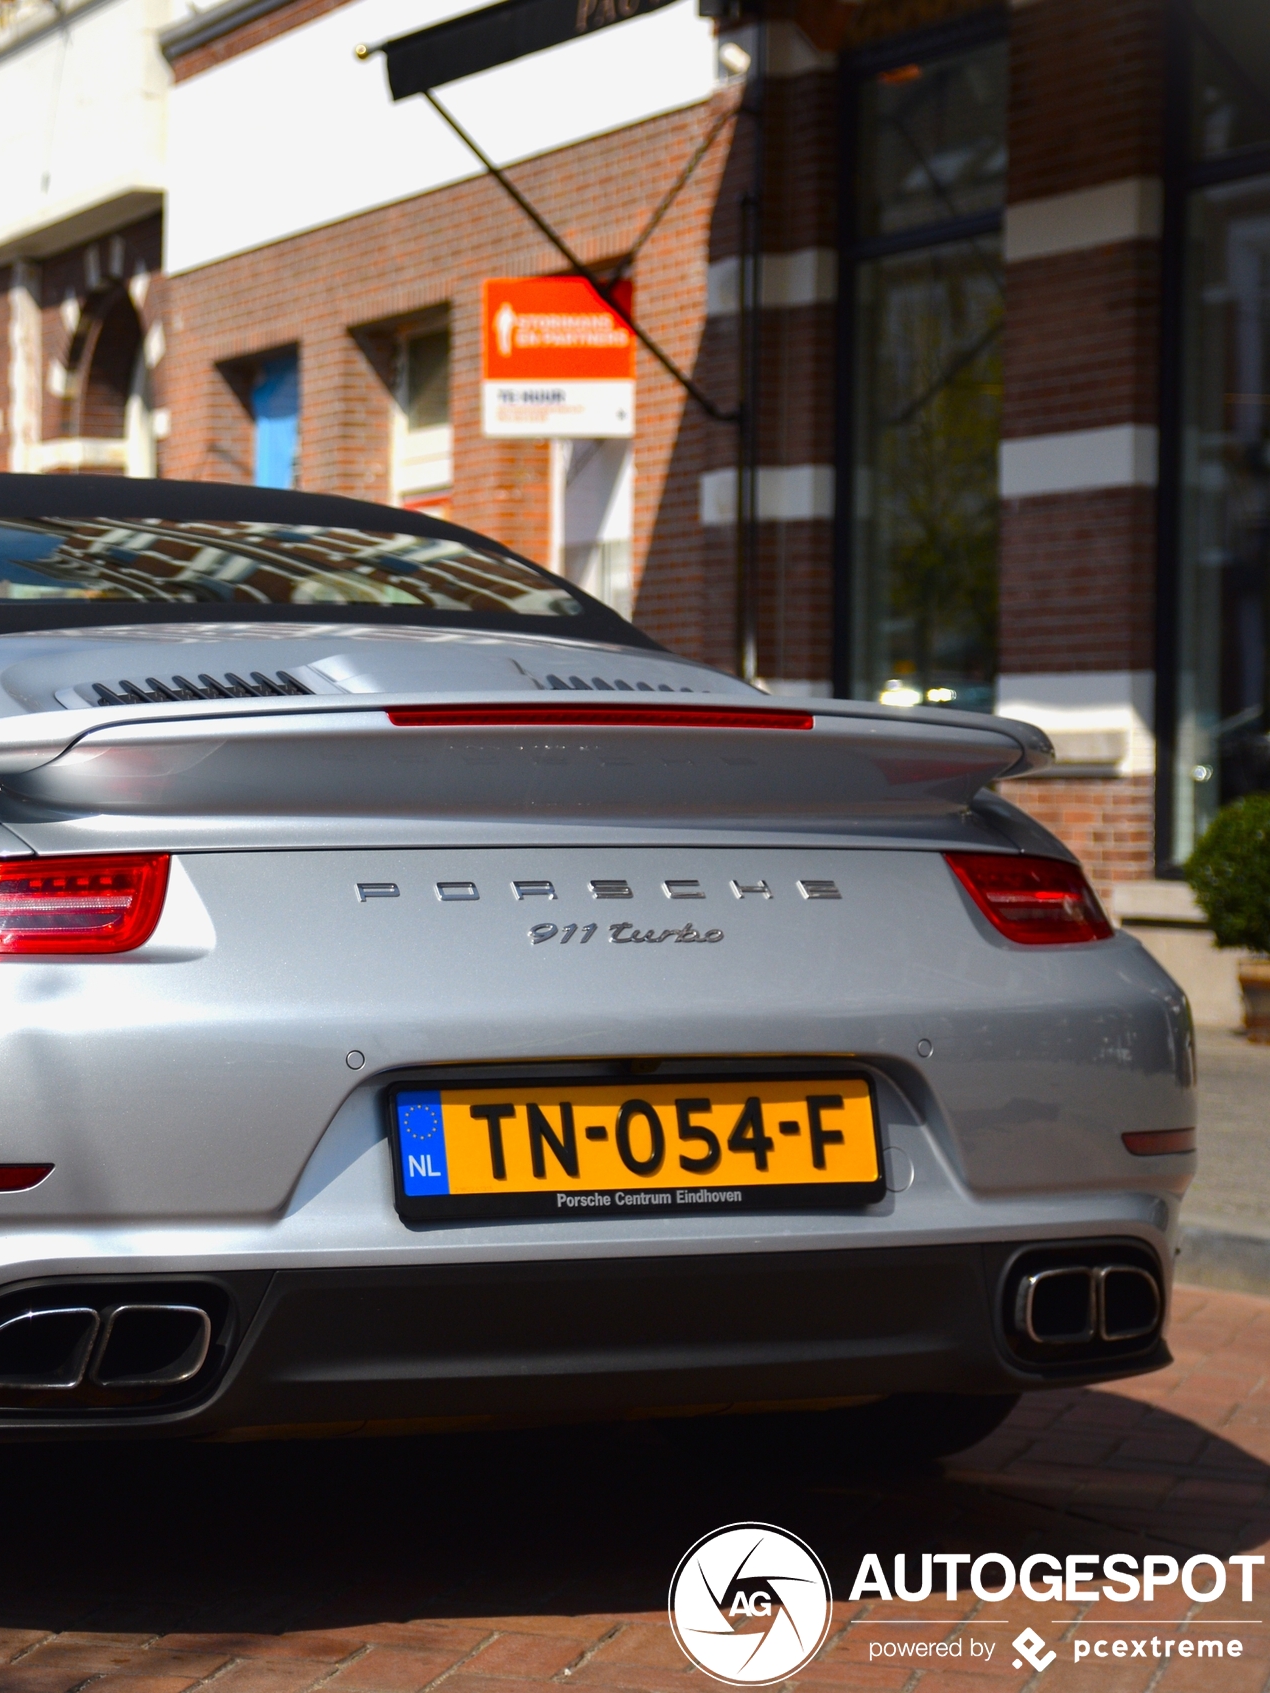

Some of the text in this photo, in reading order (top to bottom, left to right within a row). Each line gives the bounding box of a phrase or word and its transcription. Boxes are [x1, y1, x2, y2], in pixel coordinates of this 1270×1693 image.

[354, 879, 843, 902] PORSCHE
[528, 922, 725, 944] 911 turbo
[469, 1093, 846, 1181] TN-054-F
[408, 1154, 442, 1179] NL
[556, 1188, 742, 1208] Porsche Centrum Eindhoven
